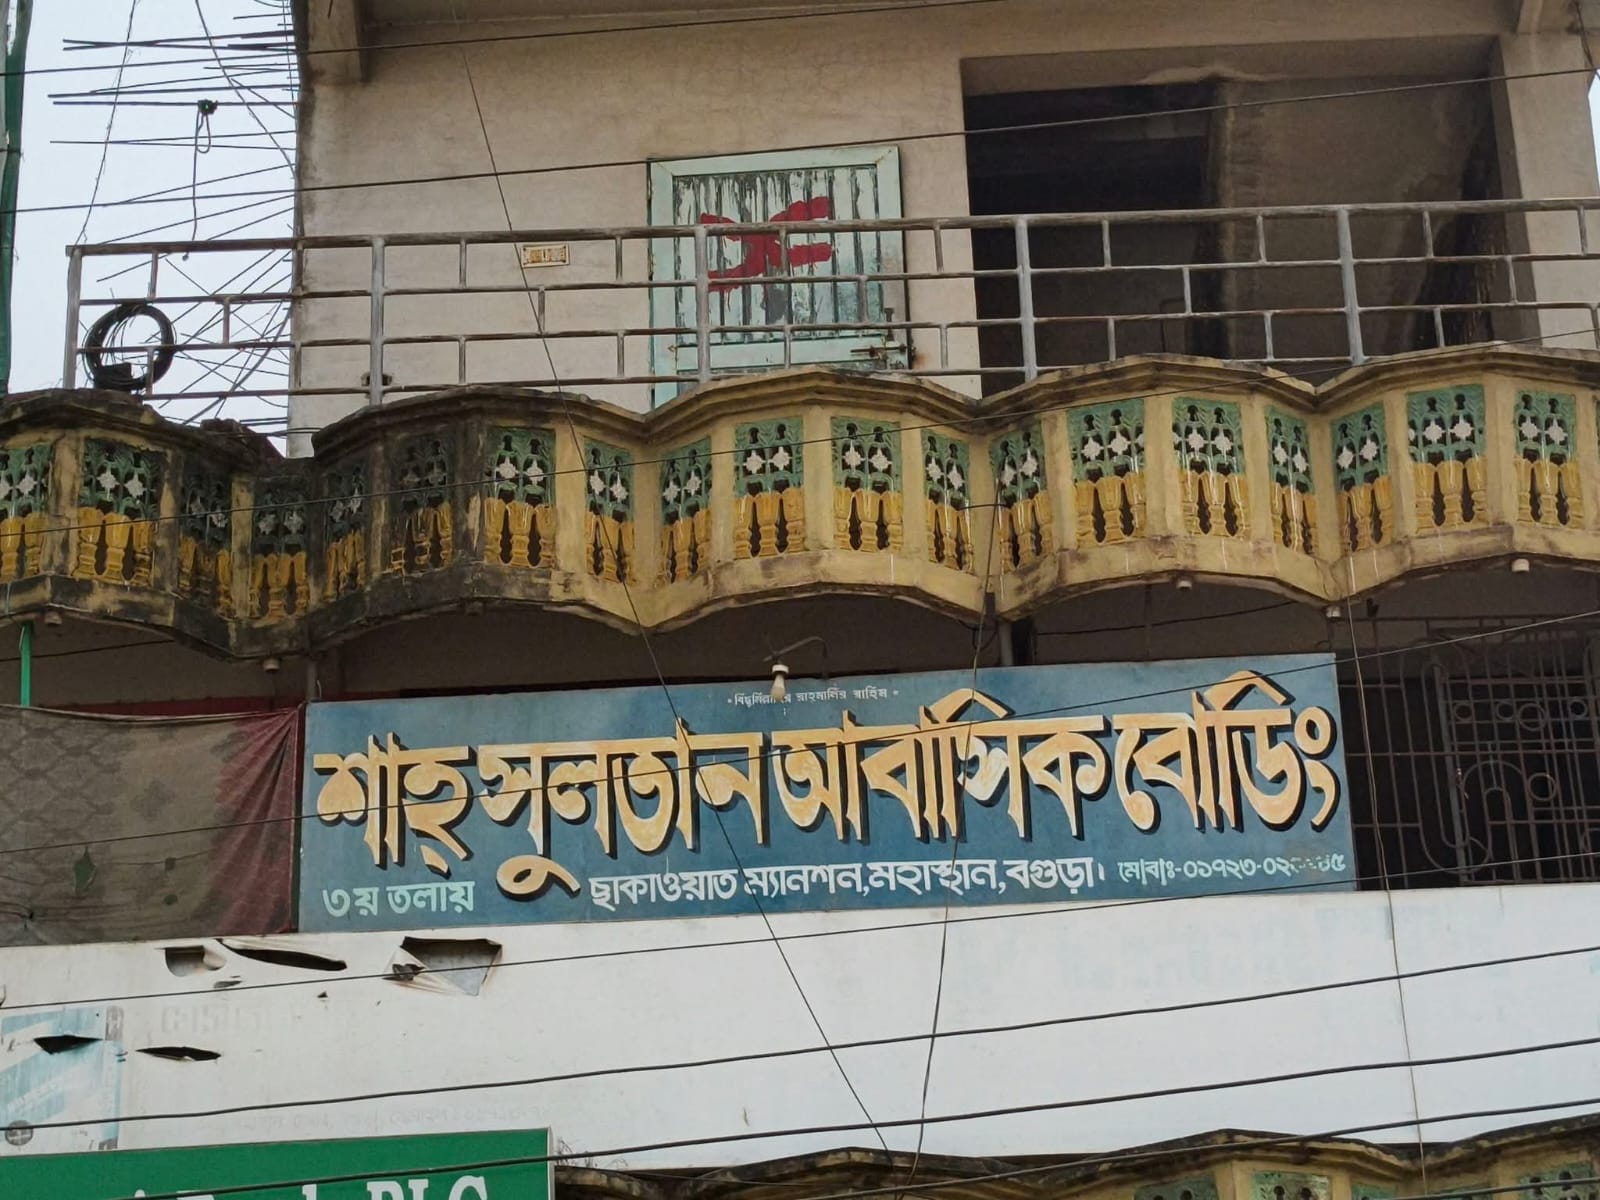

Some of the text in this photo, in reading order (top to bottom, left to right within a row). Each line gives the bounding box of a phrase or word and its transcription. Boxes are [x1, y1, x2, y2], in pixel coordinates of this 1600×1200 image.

[477, 718, 766, 897] সুলতান
[771, 687, 1108, 842] আবাসিক
[322, 881, 476, 917] ৩য় তলায়
